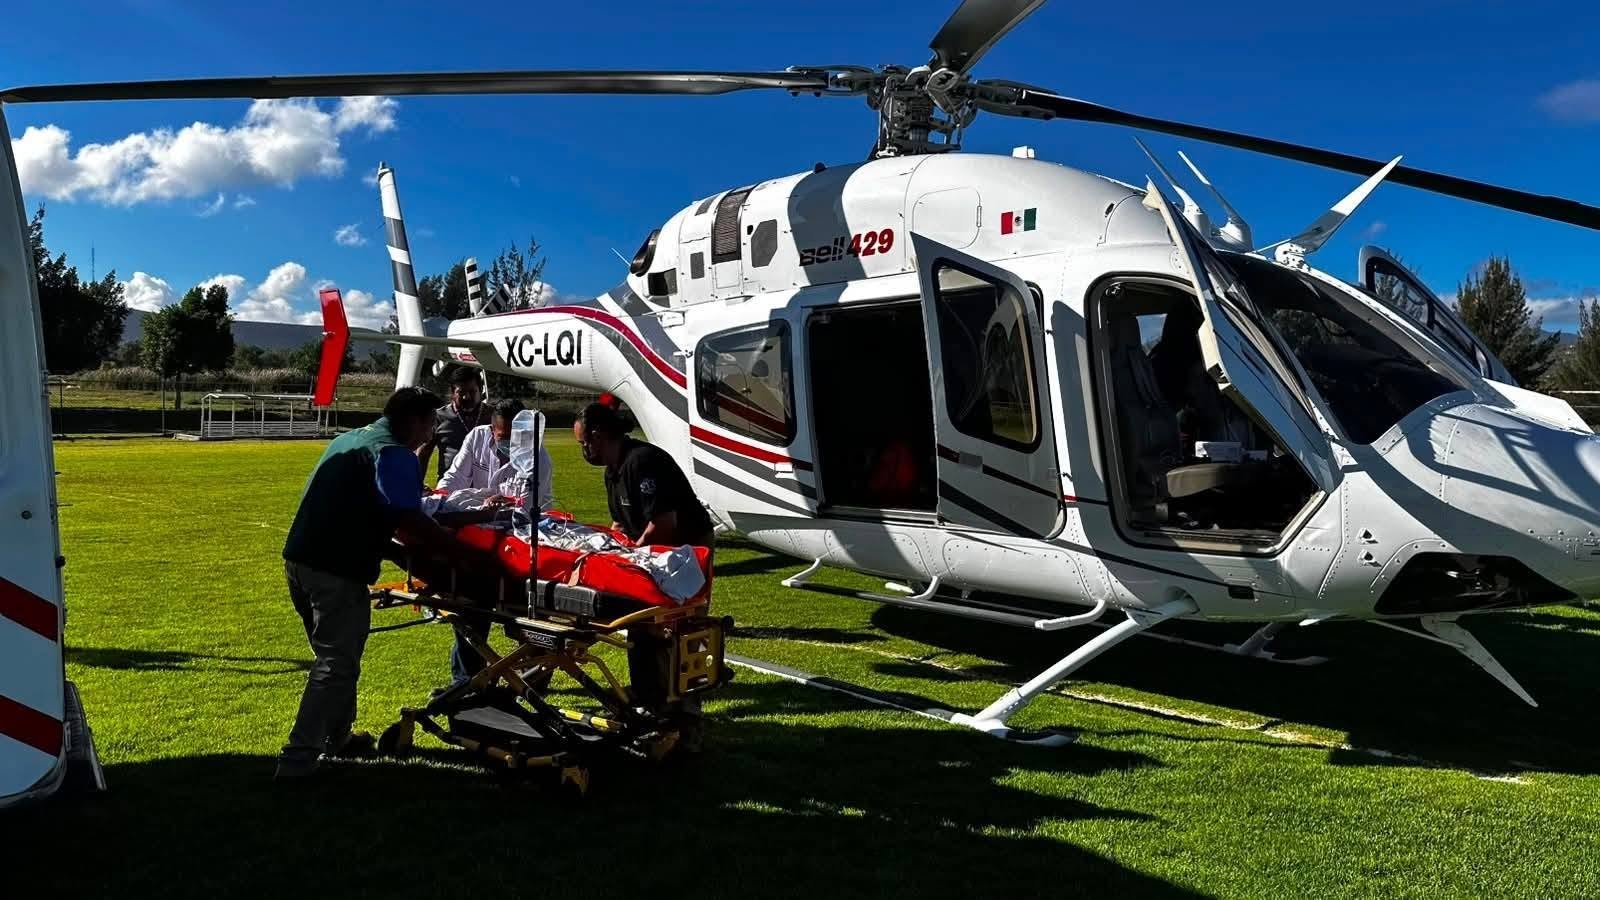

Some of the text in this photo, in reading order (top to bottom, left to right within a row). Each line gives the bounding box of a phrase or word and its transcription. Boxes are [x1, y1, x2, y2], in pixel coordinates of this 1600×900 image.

[799, 228, 894, 267] Bell 429
[504, 329, 583, 368] XC-LQI
